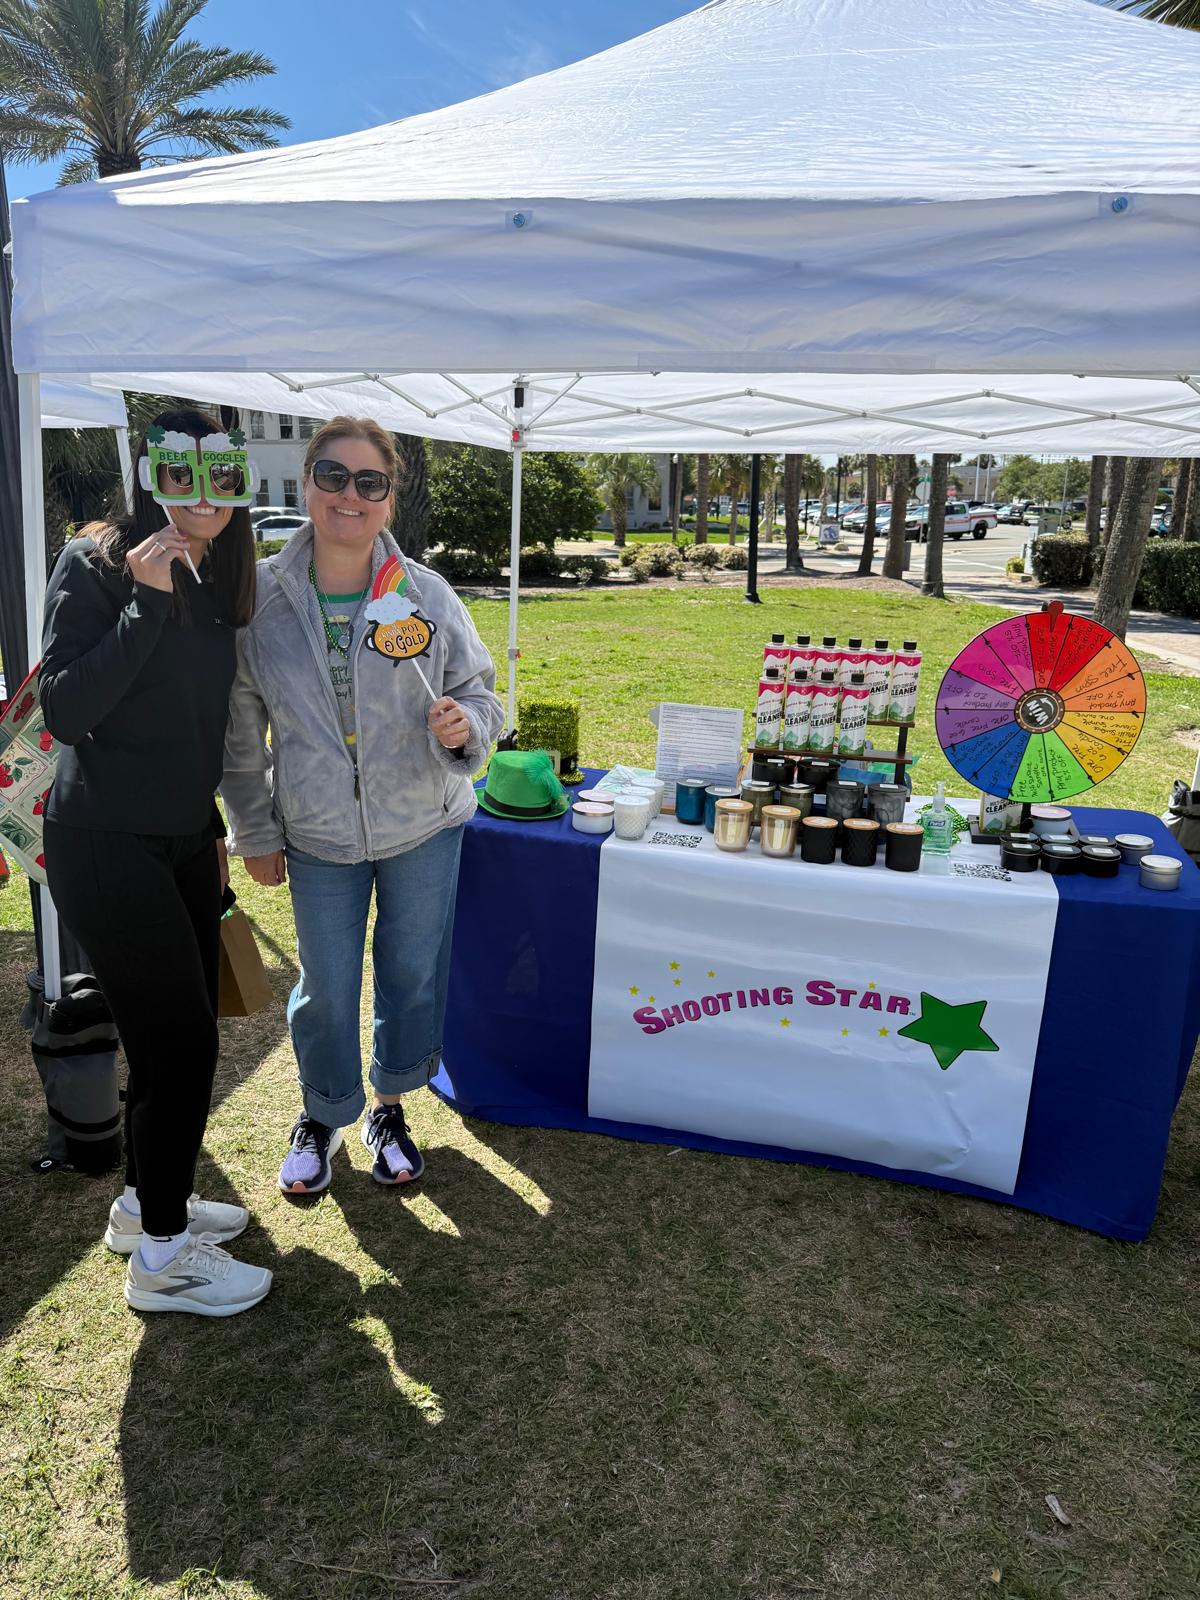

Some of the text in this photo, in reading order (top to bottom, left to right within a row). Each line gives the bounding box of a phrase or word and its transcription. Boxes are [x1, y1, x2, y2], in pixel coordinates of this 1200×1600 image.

[159, 452, 246, 463] BEER GOGGLES
[401, 623, 419, 635] POT
[396, 633, 425, 653] GOLD
[978, 664, 1019, 695] Free Spin
[1075, 654, 1127, 693] Free Spin
[336, 686, 352, 700] ay!
[870, 684, 889, 694] ANER
[891, 685, 917, 696] CLEANER
[944, 684, 963, 695] OFF
[1086, 692, 1104, 700] OFF
[1120, 698, 1136, 709] Any
[840, 717, 866, 730] CLEANER
[971, 723, 989, 732] Free
[1115, 736, 1132, 748] Free
[1055, 755, 1067, 768] OFF
[1071, 743, 1104, 774] One Free
[1017, 779, 1029, 798] Free
[985, 802, 1007, 814] CLEAN
